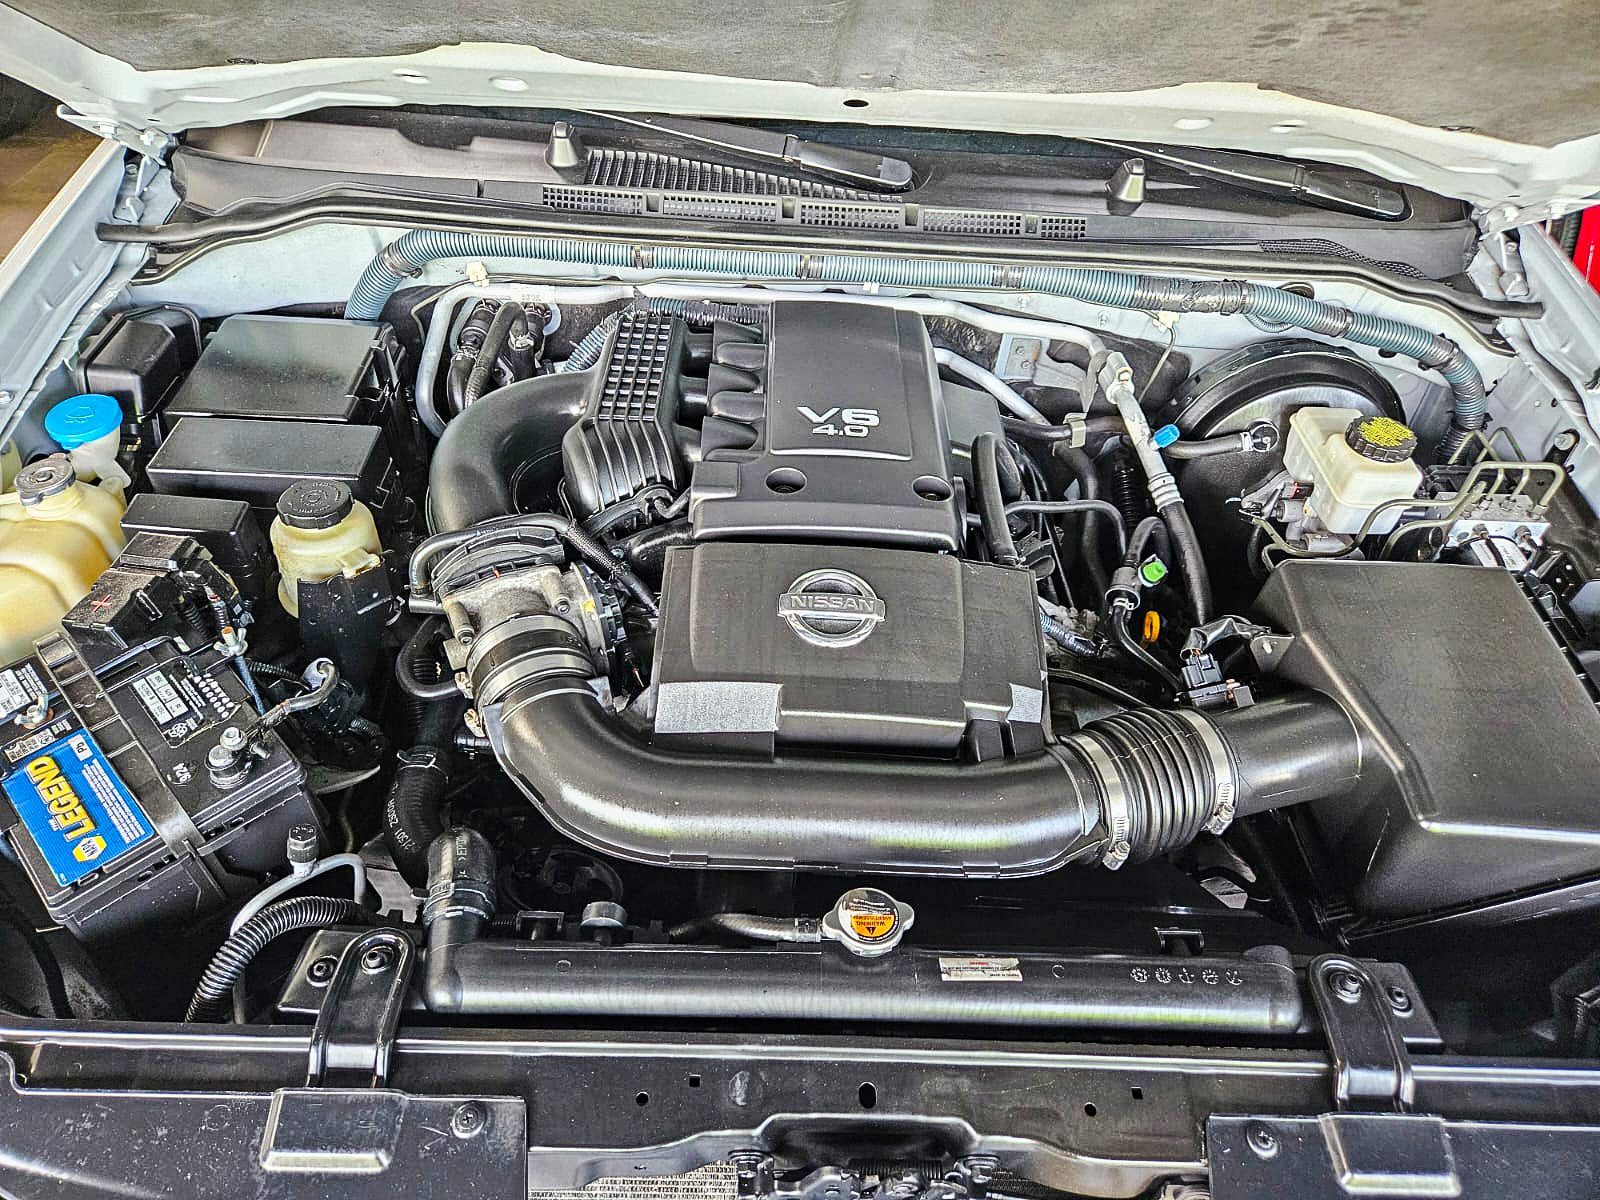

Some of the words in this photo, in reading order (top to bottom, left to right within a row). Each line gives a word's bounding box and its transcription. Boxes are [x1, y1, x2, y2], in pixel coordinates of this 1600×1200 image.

[796, 406, 880, 427] V6
[811, 423, 869, 438] 4.0
[790, 594, 875, 612] NISSAN
[25, 755, 98, 843] LEGEND
[80, 834, 98, 860] NAPA
